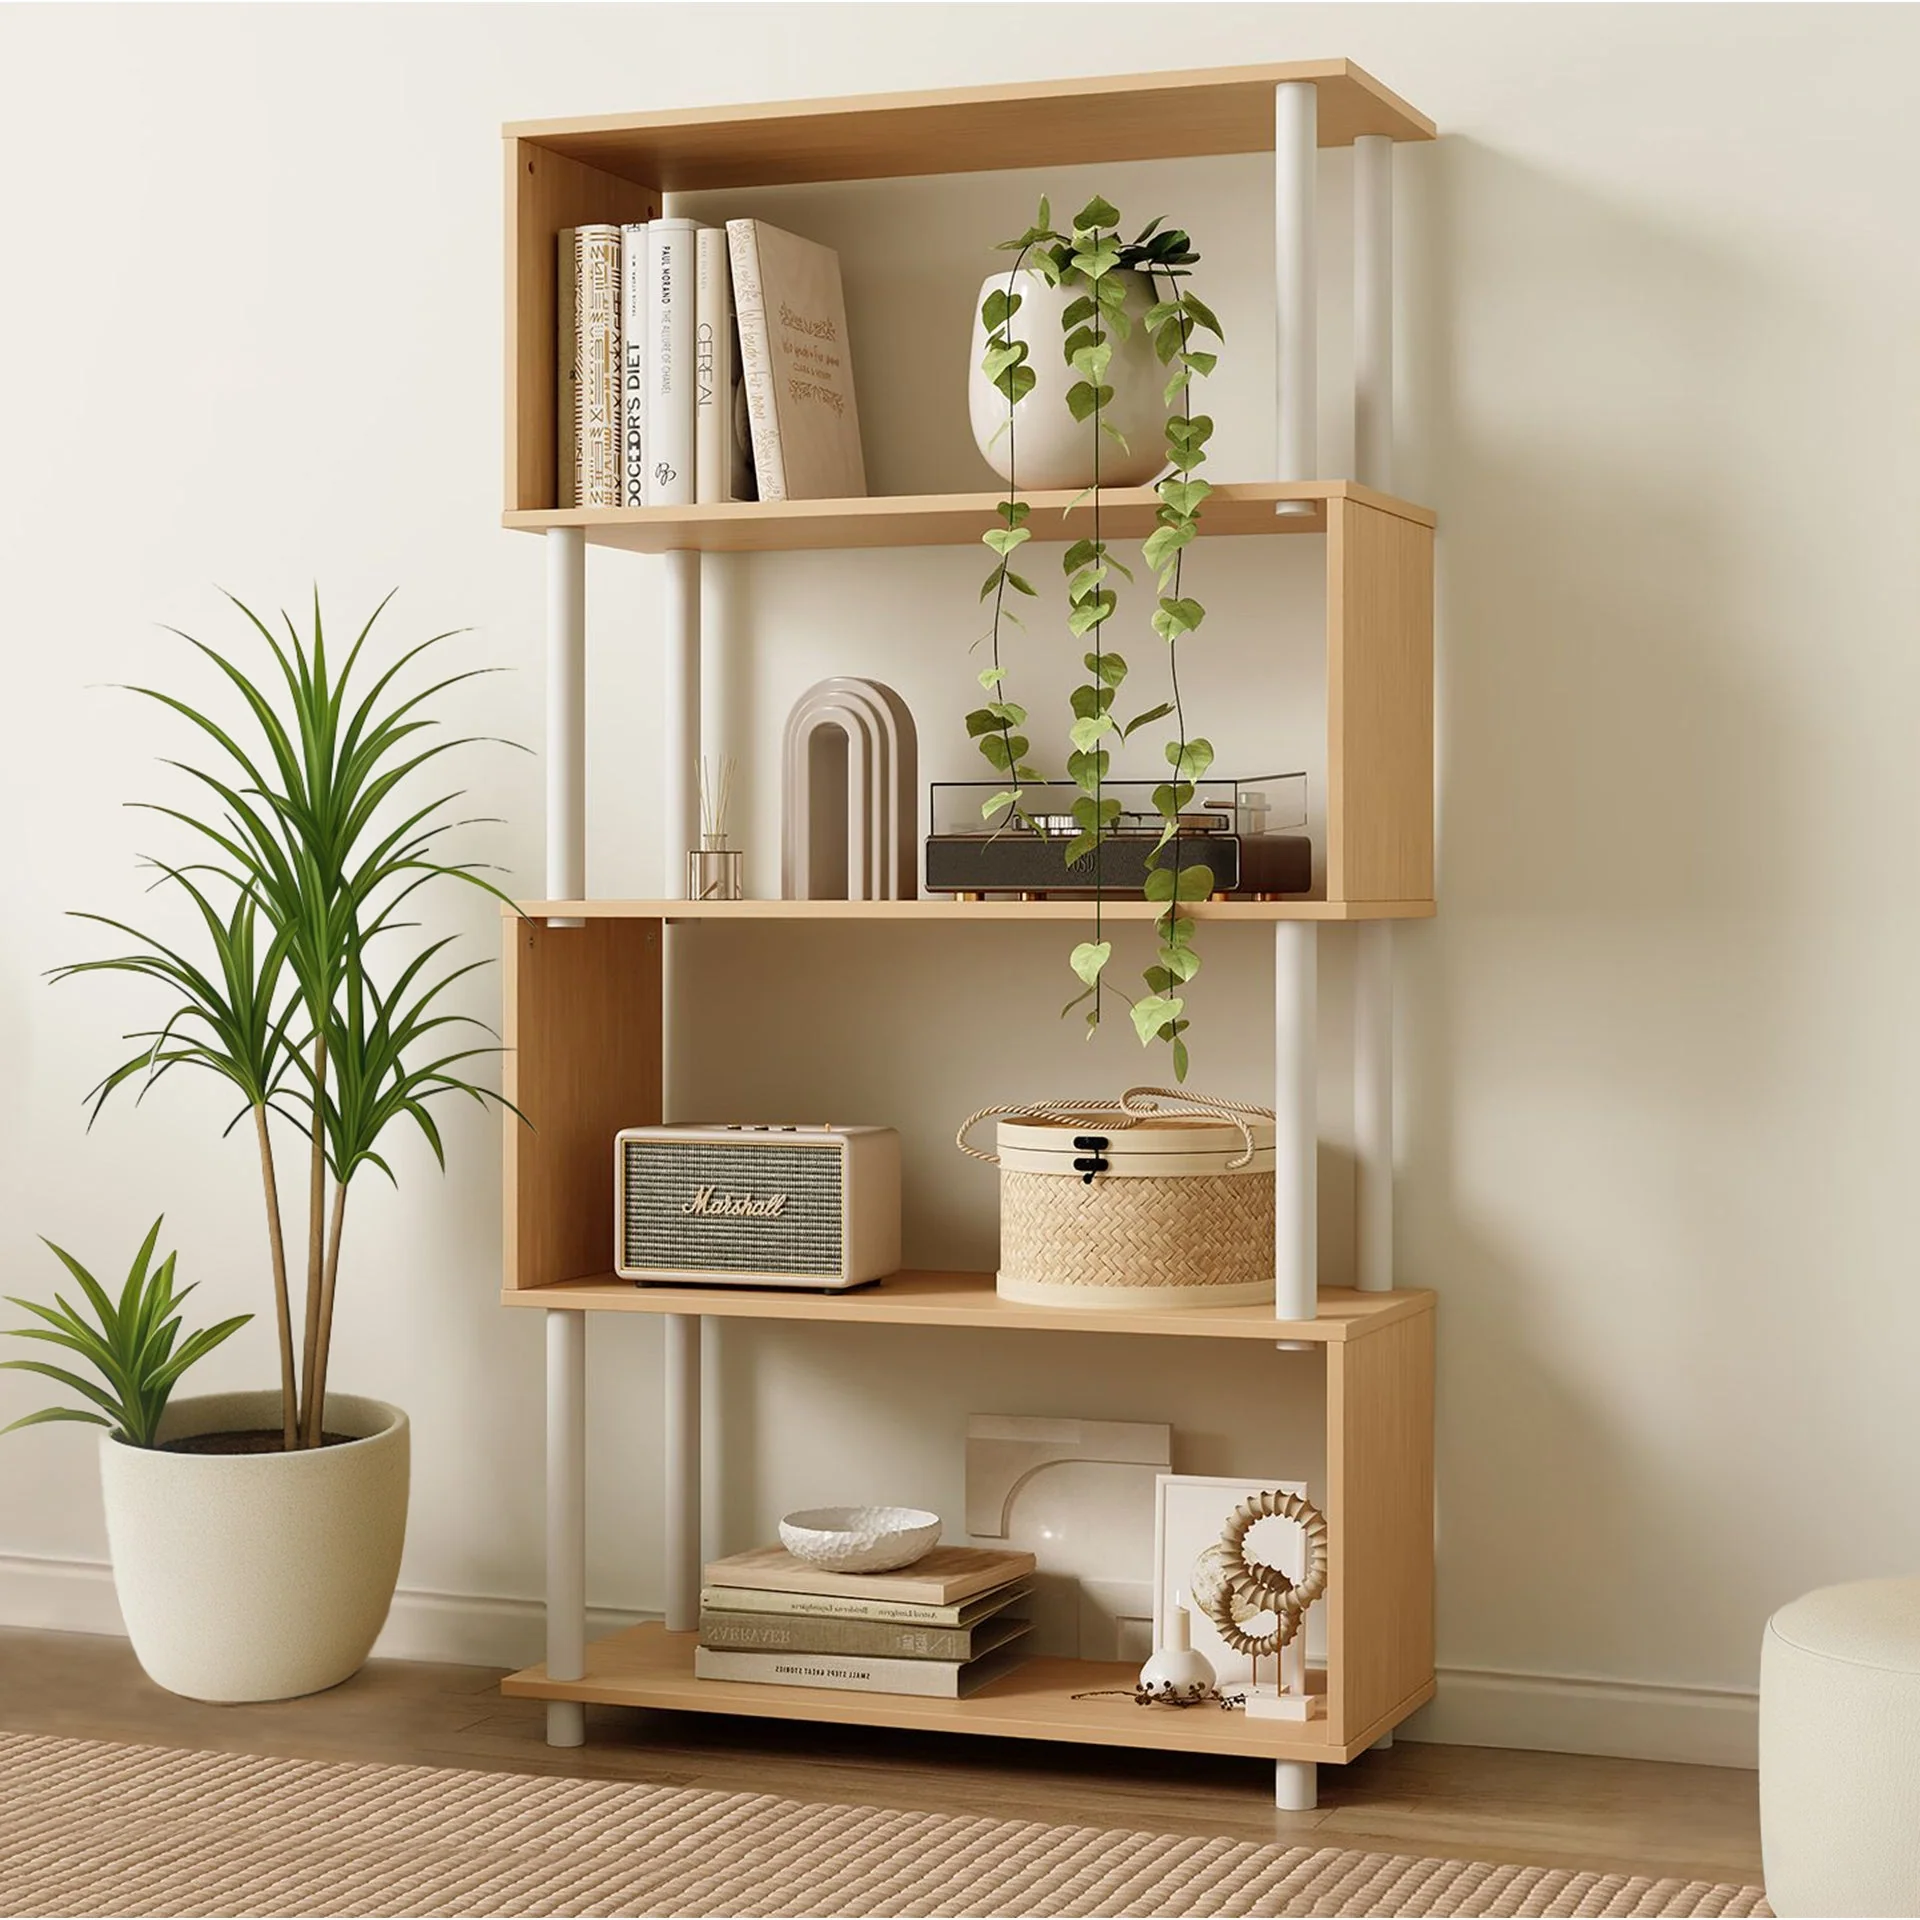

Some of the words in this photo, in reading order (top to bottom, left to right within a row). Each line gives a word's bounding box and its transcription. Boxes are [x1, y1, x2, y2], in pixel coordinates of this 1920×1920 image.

[661, 246, 672, 266] PAUL
[661, 268, 672, 304] MORAND
[661, 309, 672, 324] THE
[661, 325, 672, 352] ALLURE
[626, 340, 641, 390] DIET
[661, 354, 672, 364] OF
[698, 322, 713, 417] CEREAL
[661, 366, 672, 396] CHANEL
[682, 1185, 787, 1217] Marshall
